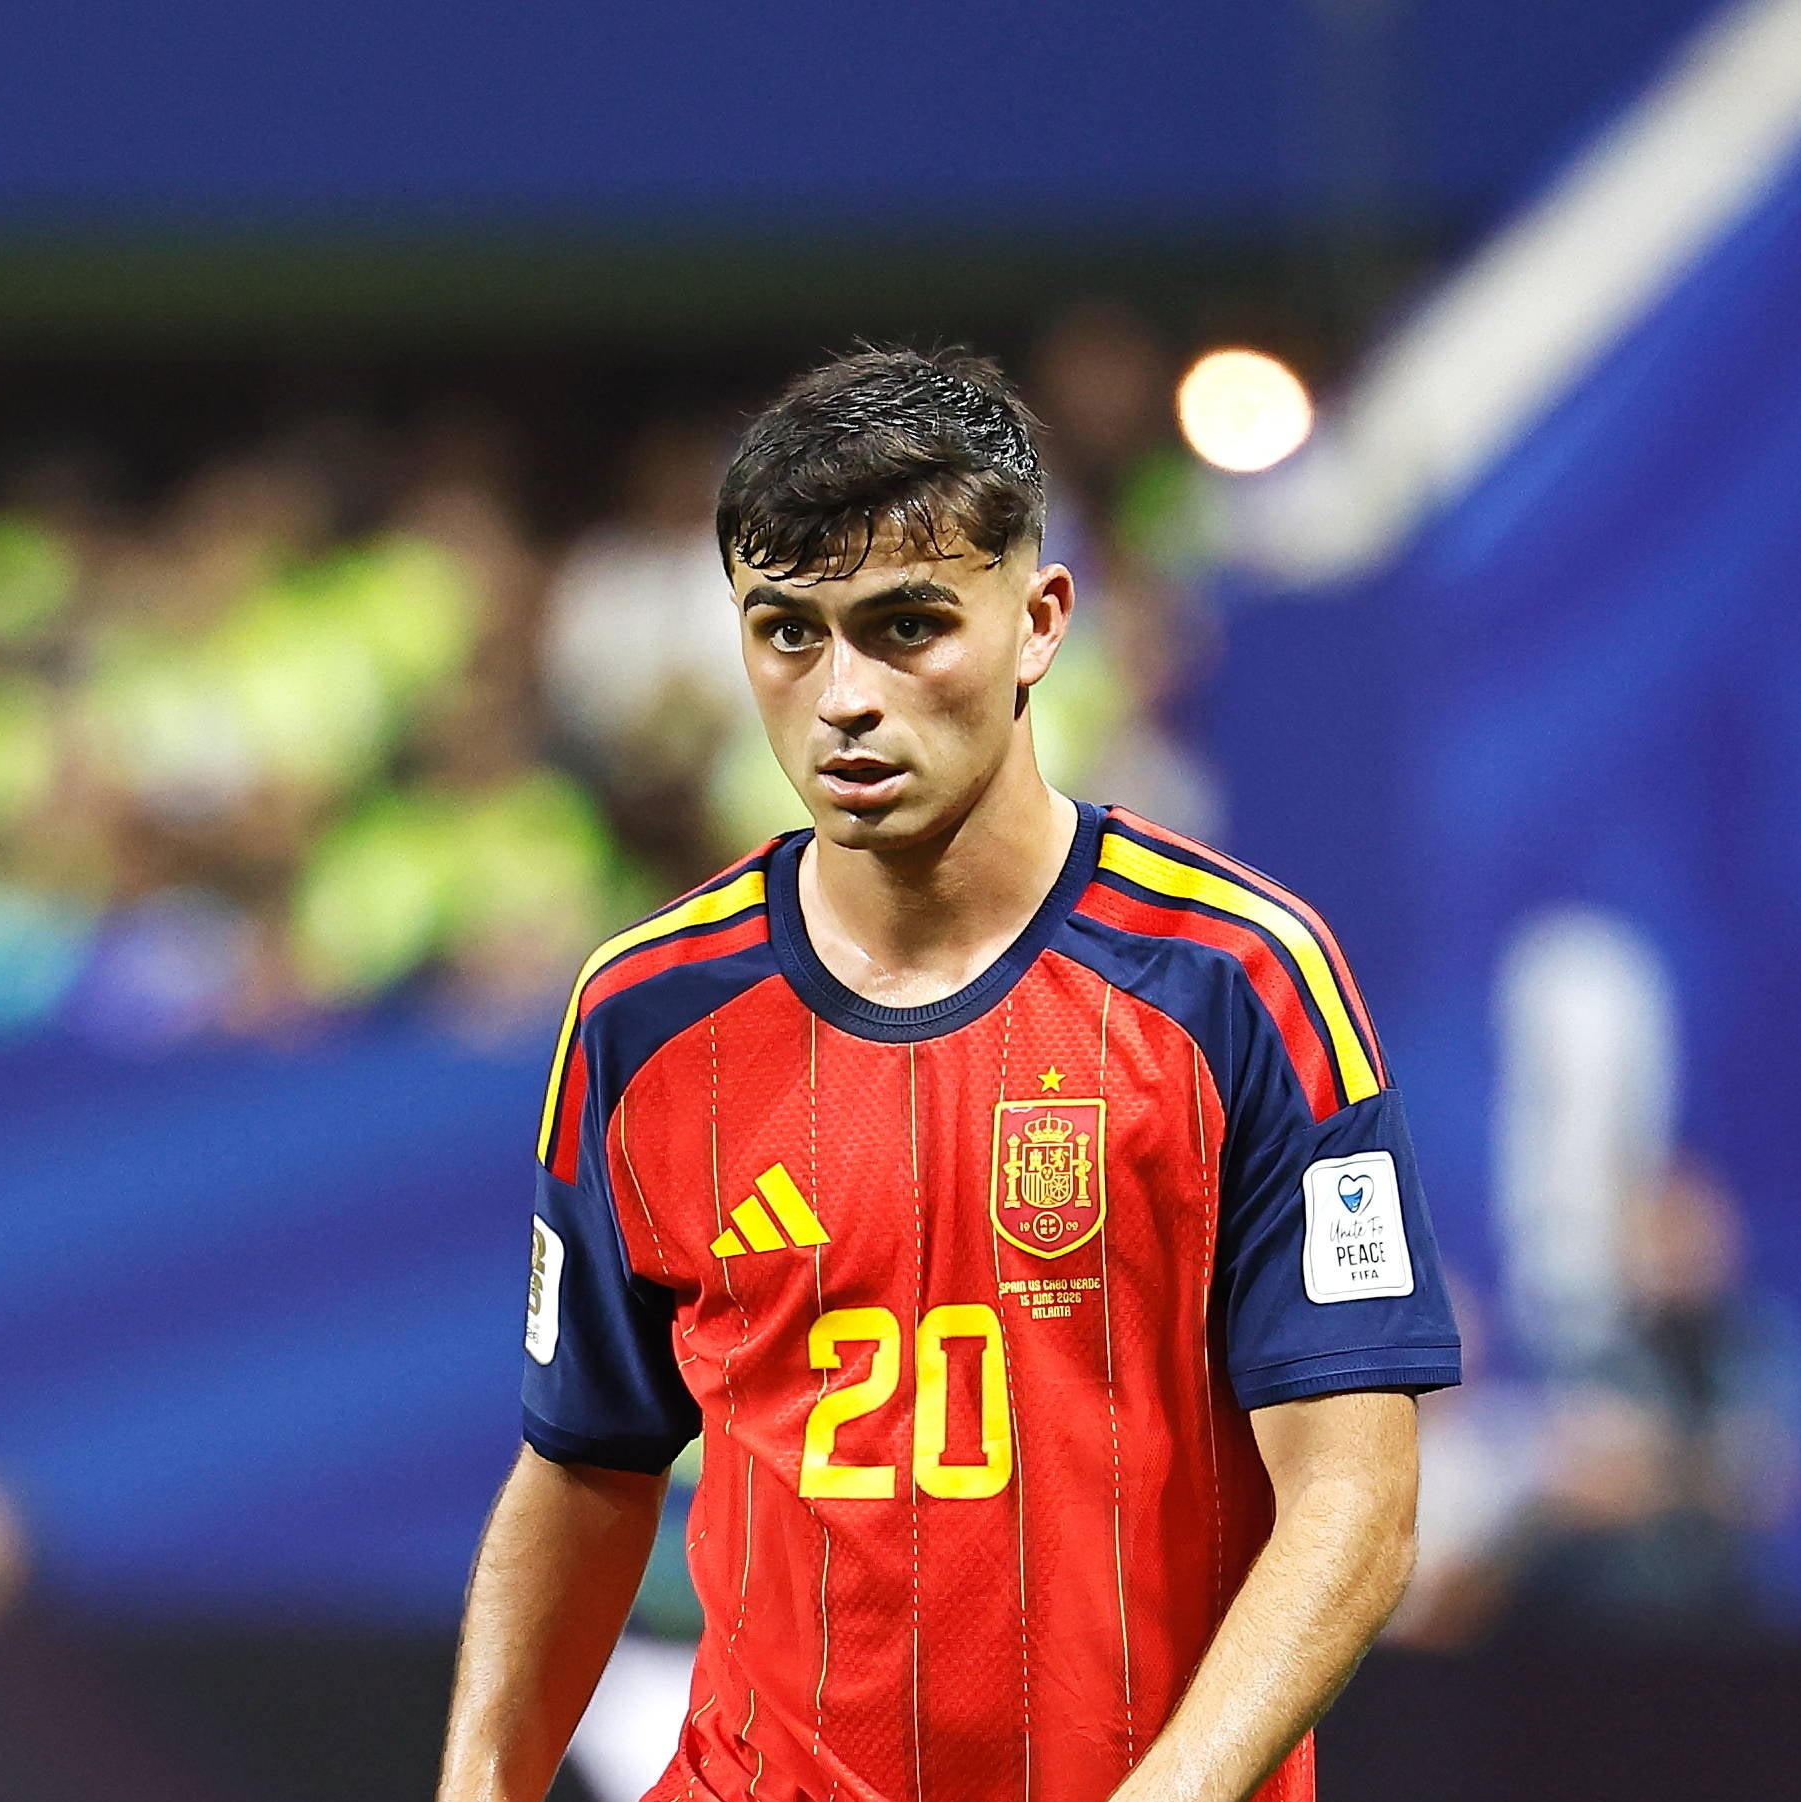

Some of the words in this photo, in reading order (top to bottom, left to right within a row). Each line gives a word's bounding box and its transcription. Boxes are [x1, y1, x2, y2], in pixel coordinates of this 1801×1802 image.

[1336, 1242, 1386, 1267] PEACE
[1351, 1269, 1379, 1281] FIFA
[999, 1281, 1027, 1293] SPAIN
[1070, 1277, 1101, 1290] VERDE
[1019, 1294, 1030, 1307] 15
[1032, 1293, 1055, 1305] JUNE
[1056, 1292, 1082, 1304] 2026
[1031, 1305, 1072, 1320] ATLANTA
[799, 1304, 1012, 1499] 20
